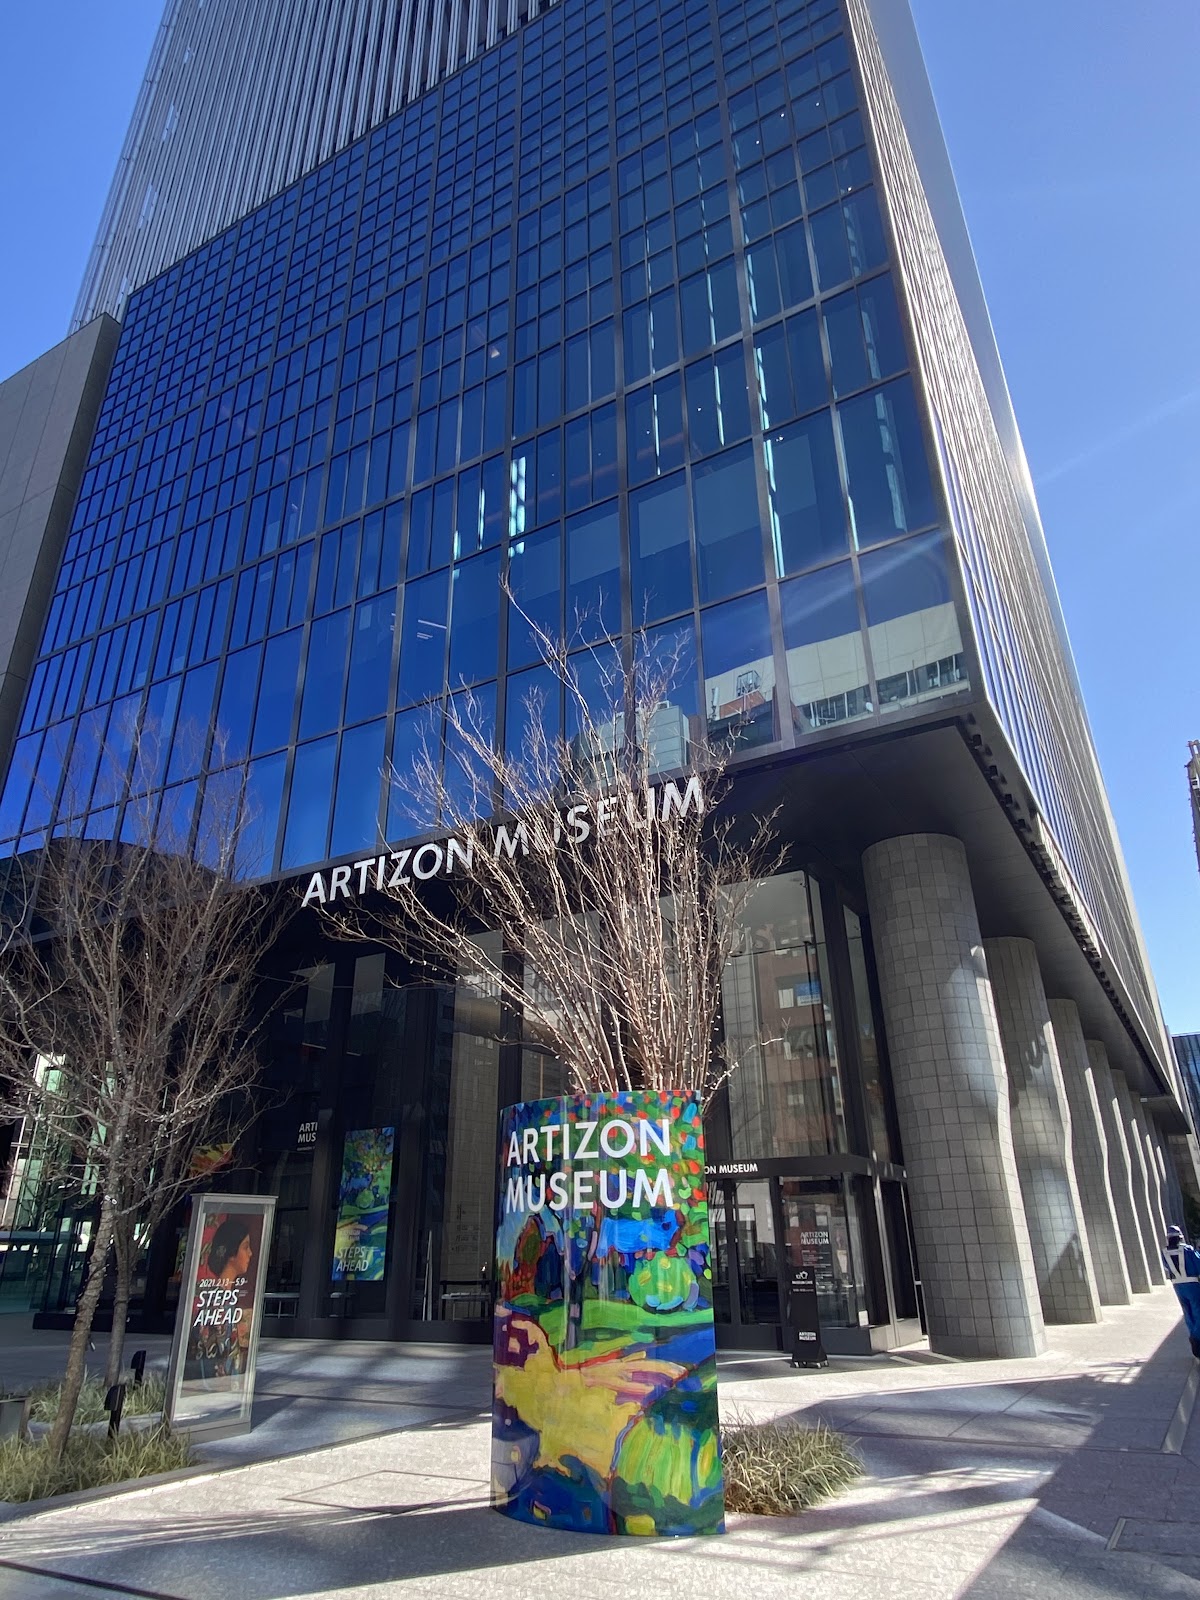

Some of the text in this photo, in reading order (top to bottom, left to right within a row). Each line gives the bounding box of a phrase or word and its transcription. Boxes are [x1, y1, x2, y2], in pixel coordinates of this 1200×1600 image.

[301, 834, 475, 908] ARTIZON
[298, 1122, 318, 1132] ARTI
[297, 1132, 316, 1143] MUS
[506, 1118, 672, 1167] ARTIZON
[719, 1163, 758, 1173] MUSEUM
[506, 1168, 674, 1214] MUSEUM
[337, 1246, 367, 1259] STEPS
[335, 1259, 369, 1272] AHEAD
[197, 1289, 240, 1307] STEPS
[193, 1308, 243, 1326] AHEAD
